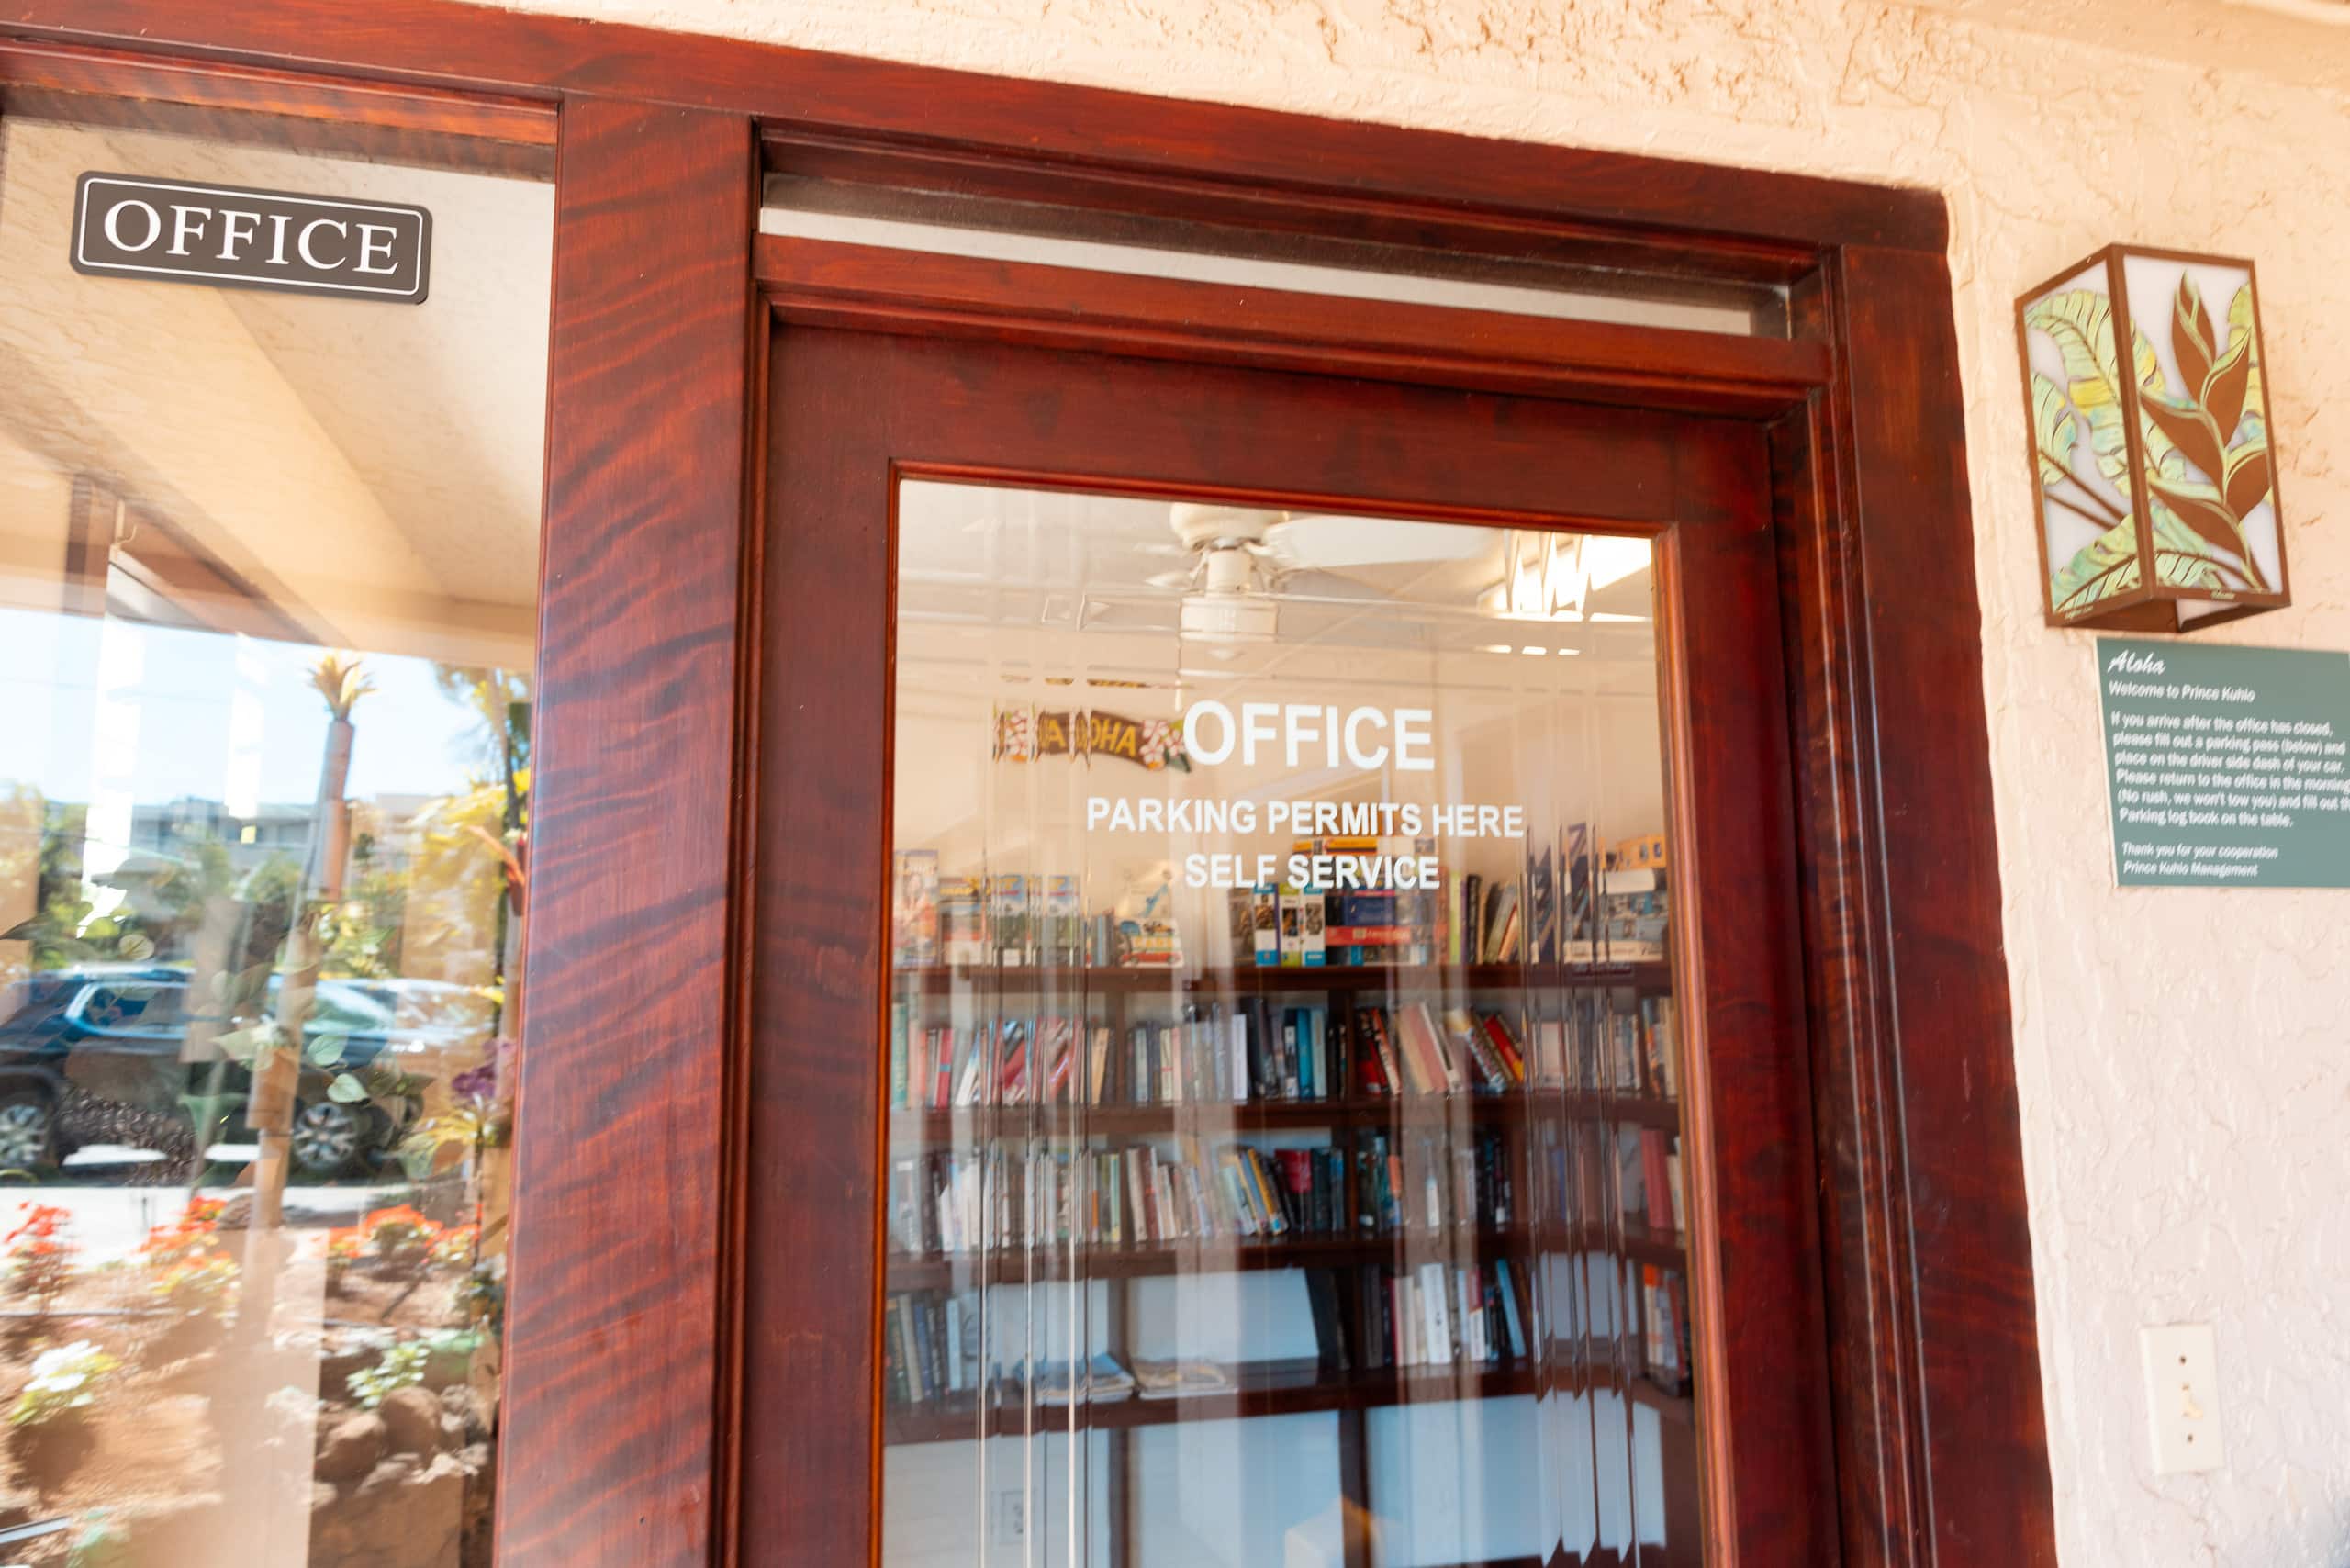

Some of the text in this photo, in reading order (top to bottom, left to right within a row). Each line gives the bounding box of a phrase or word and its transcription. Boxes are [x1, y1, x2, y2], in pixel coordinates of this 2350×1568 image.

[104, 199, 399, 275] OFFICE
[2108, 650, 2166, 675] Aloha
[2109, 680, 2255, 703] Welcome to Prince Kuhio
[1182, 700, 1435, 771] OFFICE
[2111, 711, 2333, 737] If you arrive after the office has closed,
[2113, 731, 2345, 756] please fill out a parking pass (below) and
[2114, 749, 2147, 767] place
[2149, 754, 2165, 767] on
[2167, 752, 2188, 767] the
[2189, 753, 2223, 769] driver
[2225, 754, 2251, 769] side
[2252, 756, 2281, 771] dash
[2283, 756, 2295, 772] of
[2297, 759, 2322, 775] your
[2116, 768, 2157, 786] Please
[2159, 772, 2196, 787] return
[2198, 773, 2211, 787] to
[2212, 772, 2232, 788] the
[2234, 773, 2268, 790] office
[2269, 774, 2281, 790] in
[2282, 775, 2303, 790] the
[2117, 788, 2350, 811] (No rush, we won't tow you) and fill out th
[1087, 797, 1524, 838] PARKING PERMITS HERE
[2120, 807, 2294, 828] Parking log book on the table.
[2122, 841, 2279, 860] Thank you for your cooperation
[1184, 853, 1440, 890] SELF SERVICE
[2123, 860, 2258, 879] Prince Kuhio Management
